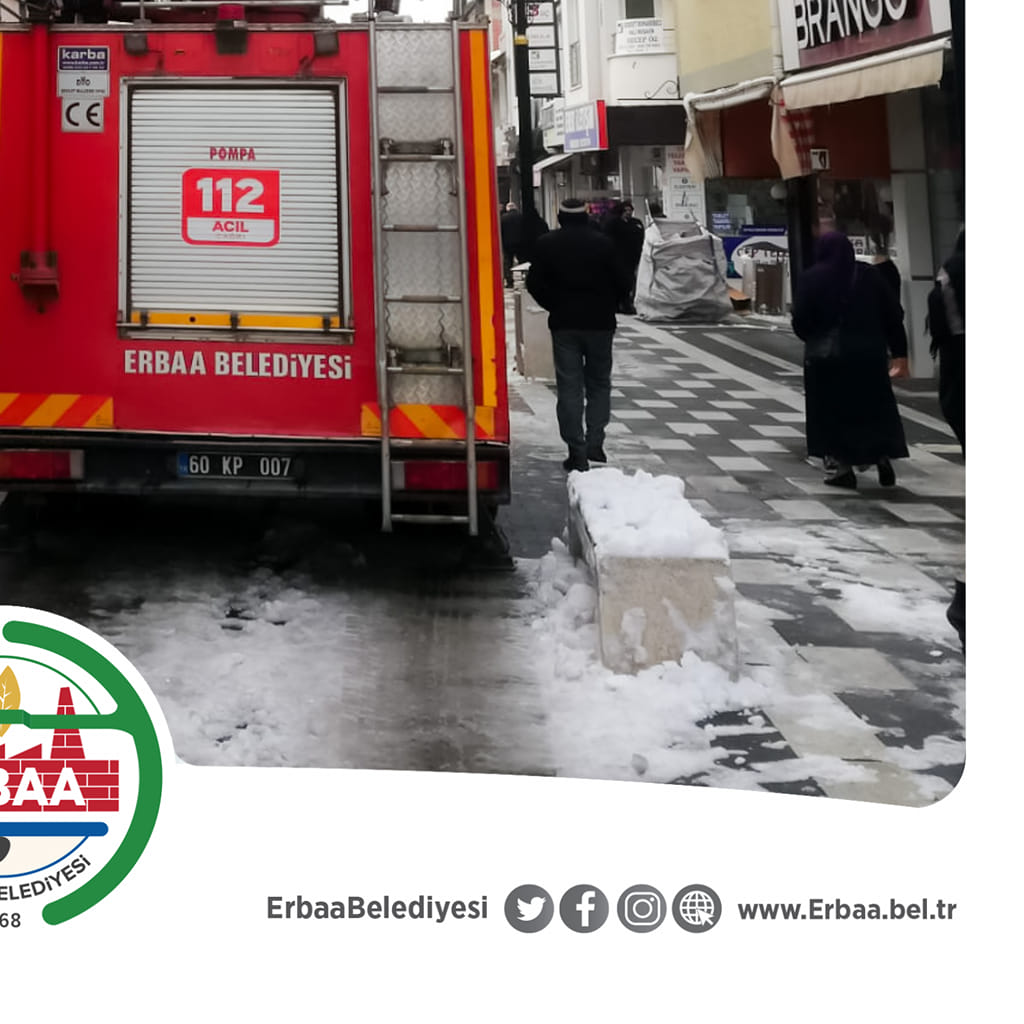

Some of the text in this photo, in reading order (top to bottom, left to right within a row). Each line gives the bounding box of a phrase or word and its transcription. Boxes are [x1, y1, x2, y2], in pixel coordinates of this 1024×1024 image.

[62, 48, 106, 59] karba
[65, 102, 101, 127] CE
[209, 146, 256, 161] POMPA
[196, 177, 264, 213] 112
[124, 350, 207, 375] ERBAA
[189, 455, 210, 474] 60
[222, 456, 243, 476] KP
[260, 457, 292, 477] 007
